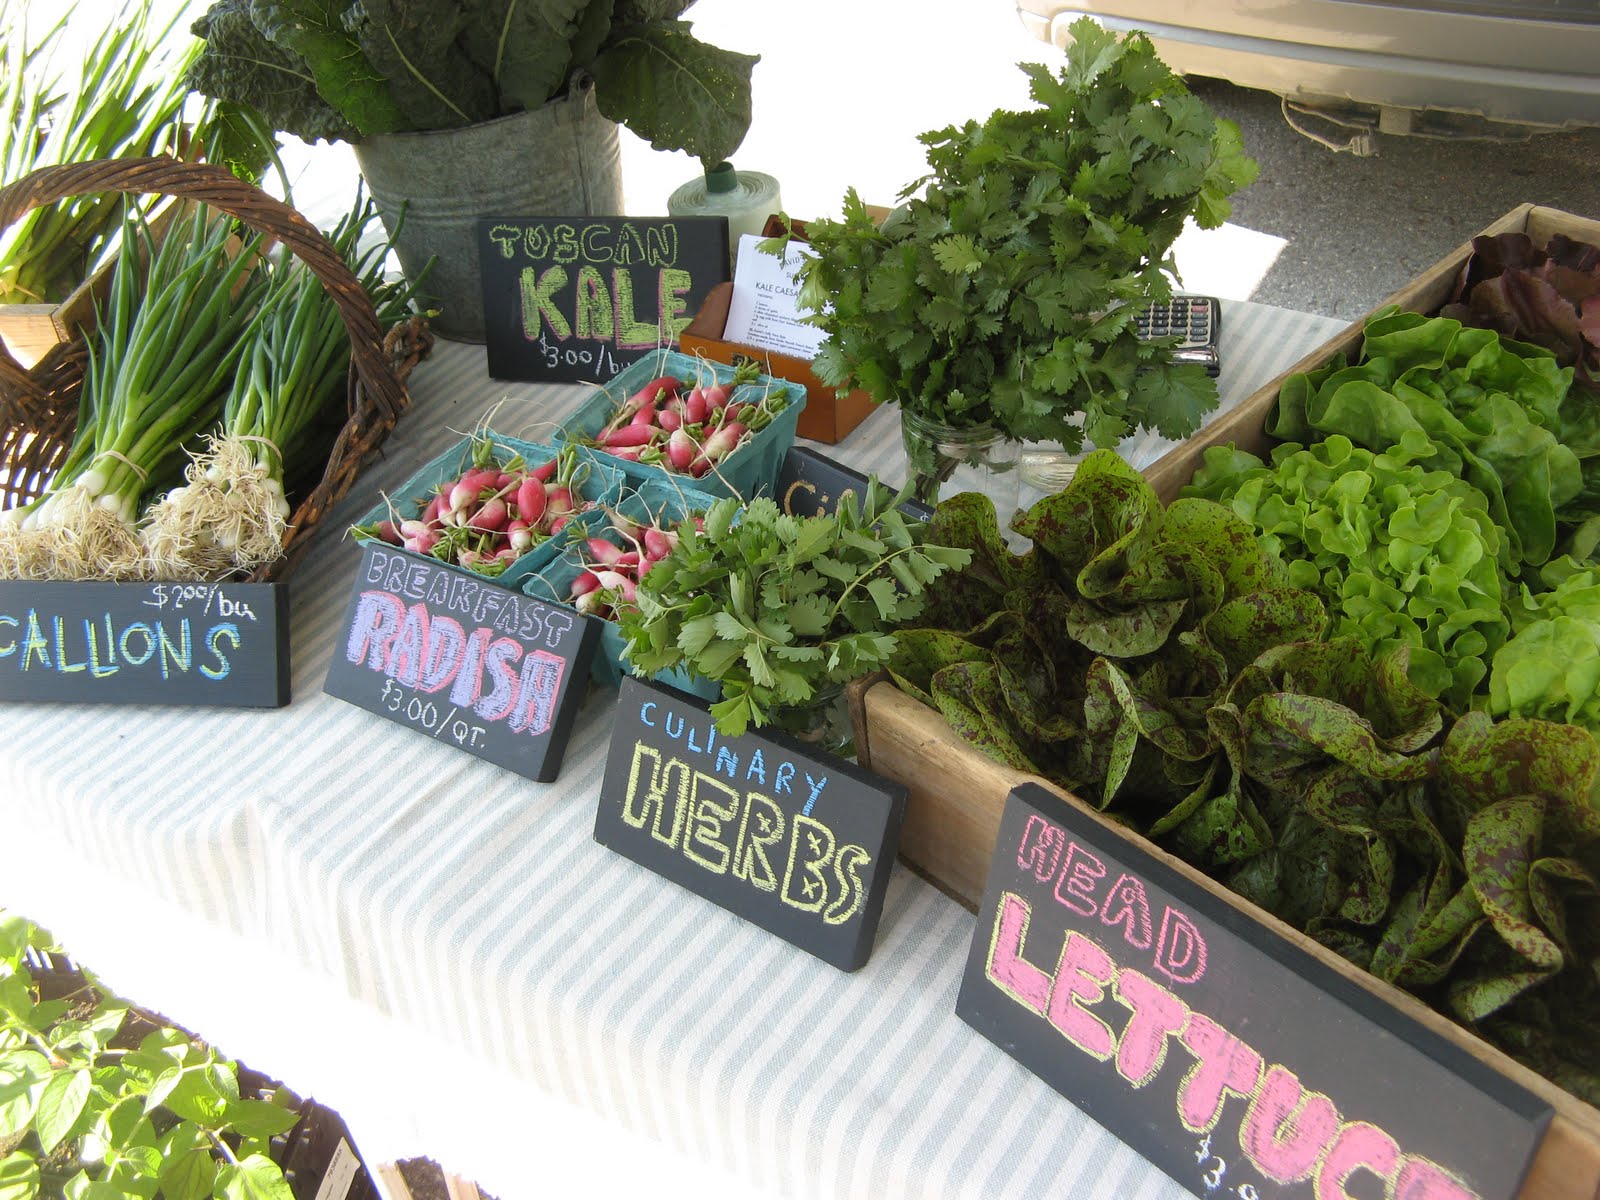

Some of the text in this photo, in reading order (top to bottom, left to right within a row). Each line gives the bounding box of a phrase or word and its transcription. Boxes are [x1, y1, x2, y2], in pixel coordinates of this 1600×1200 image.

[489, 222, 679, 267] TUSCAN
[755, 281, 774, 293] KALE
[774, 285, 799, 297] CAESA
[779, 256, 806, 269] AVID'S
[519, 264, 694, 350] KALE
[367, 551, 574, 648] BREAKFAST
[347, 589, 567, 736] RADISH
[381, 678, 487, 748] $3.00/QT.
[640, 701, 828, 816] CULINARY
[621, 738, 872, 925] HERBS
[1017, 814, 1209, 984] HEAD
